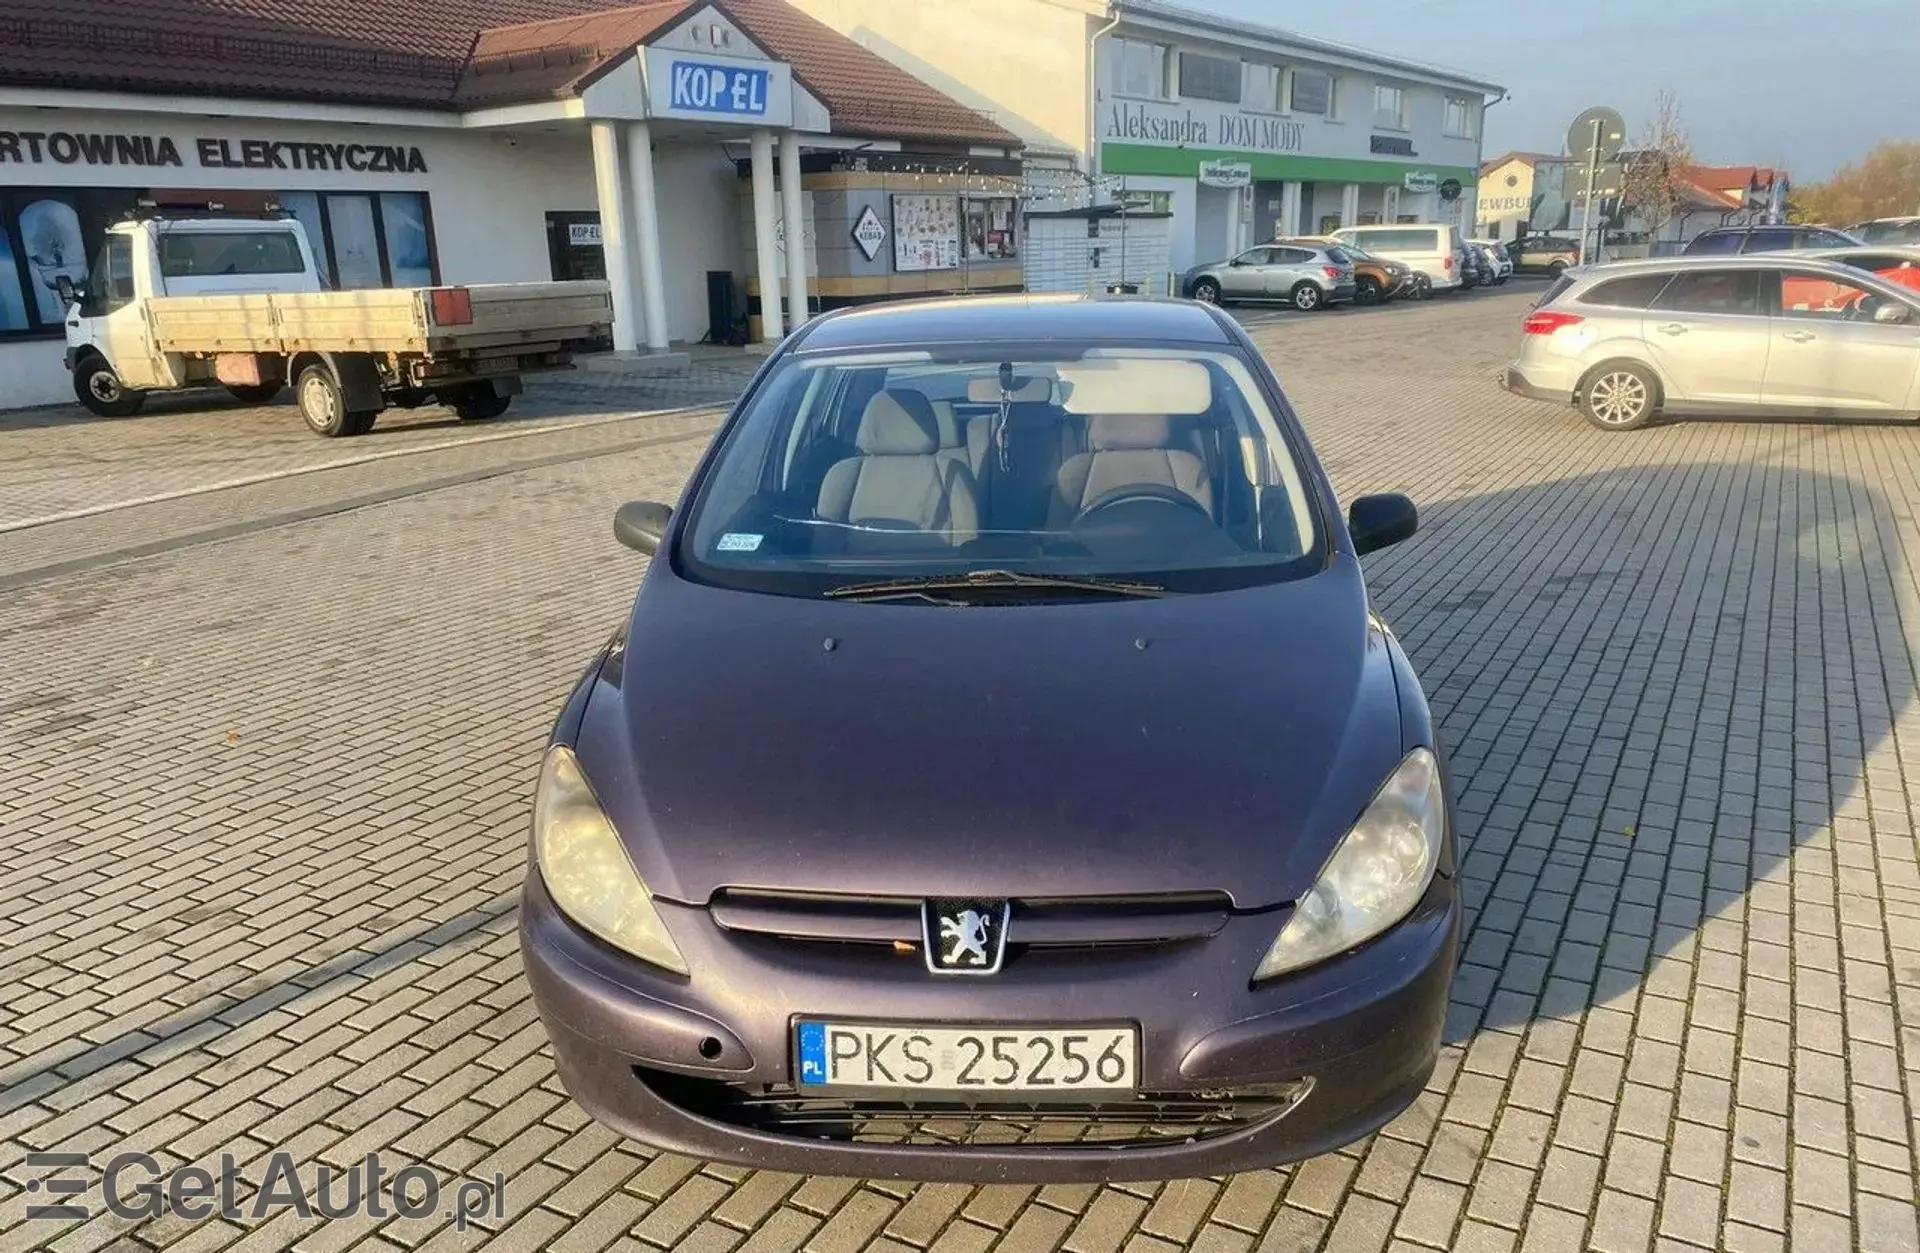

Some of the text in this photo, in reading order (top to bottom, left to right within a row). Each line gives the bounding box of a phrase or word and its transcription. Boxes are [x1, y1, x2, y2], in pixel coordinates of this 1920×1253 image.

[1107, 103, 1305, 151] Aleksandra DOM MODY
[196, 138, 428, 173] ELEKTRYCZNA
[1479, 197, 1531, 210] EWBU
[802, 1060, 823, 1075] PL
[830, 1031, 1126, 1085] PKS 25256
